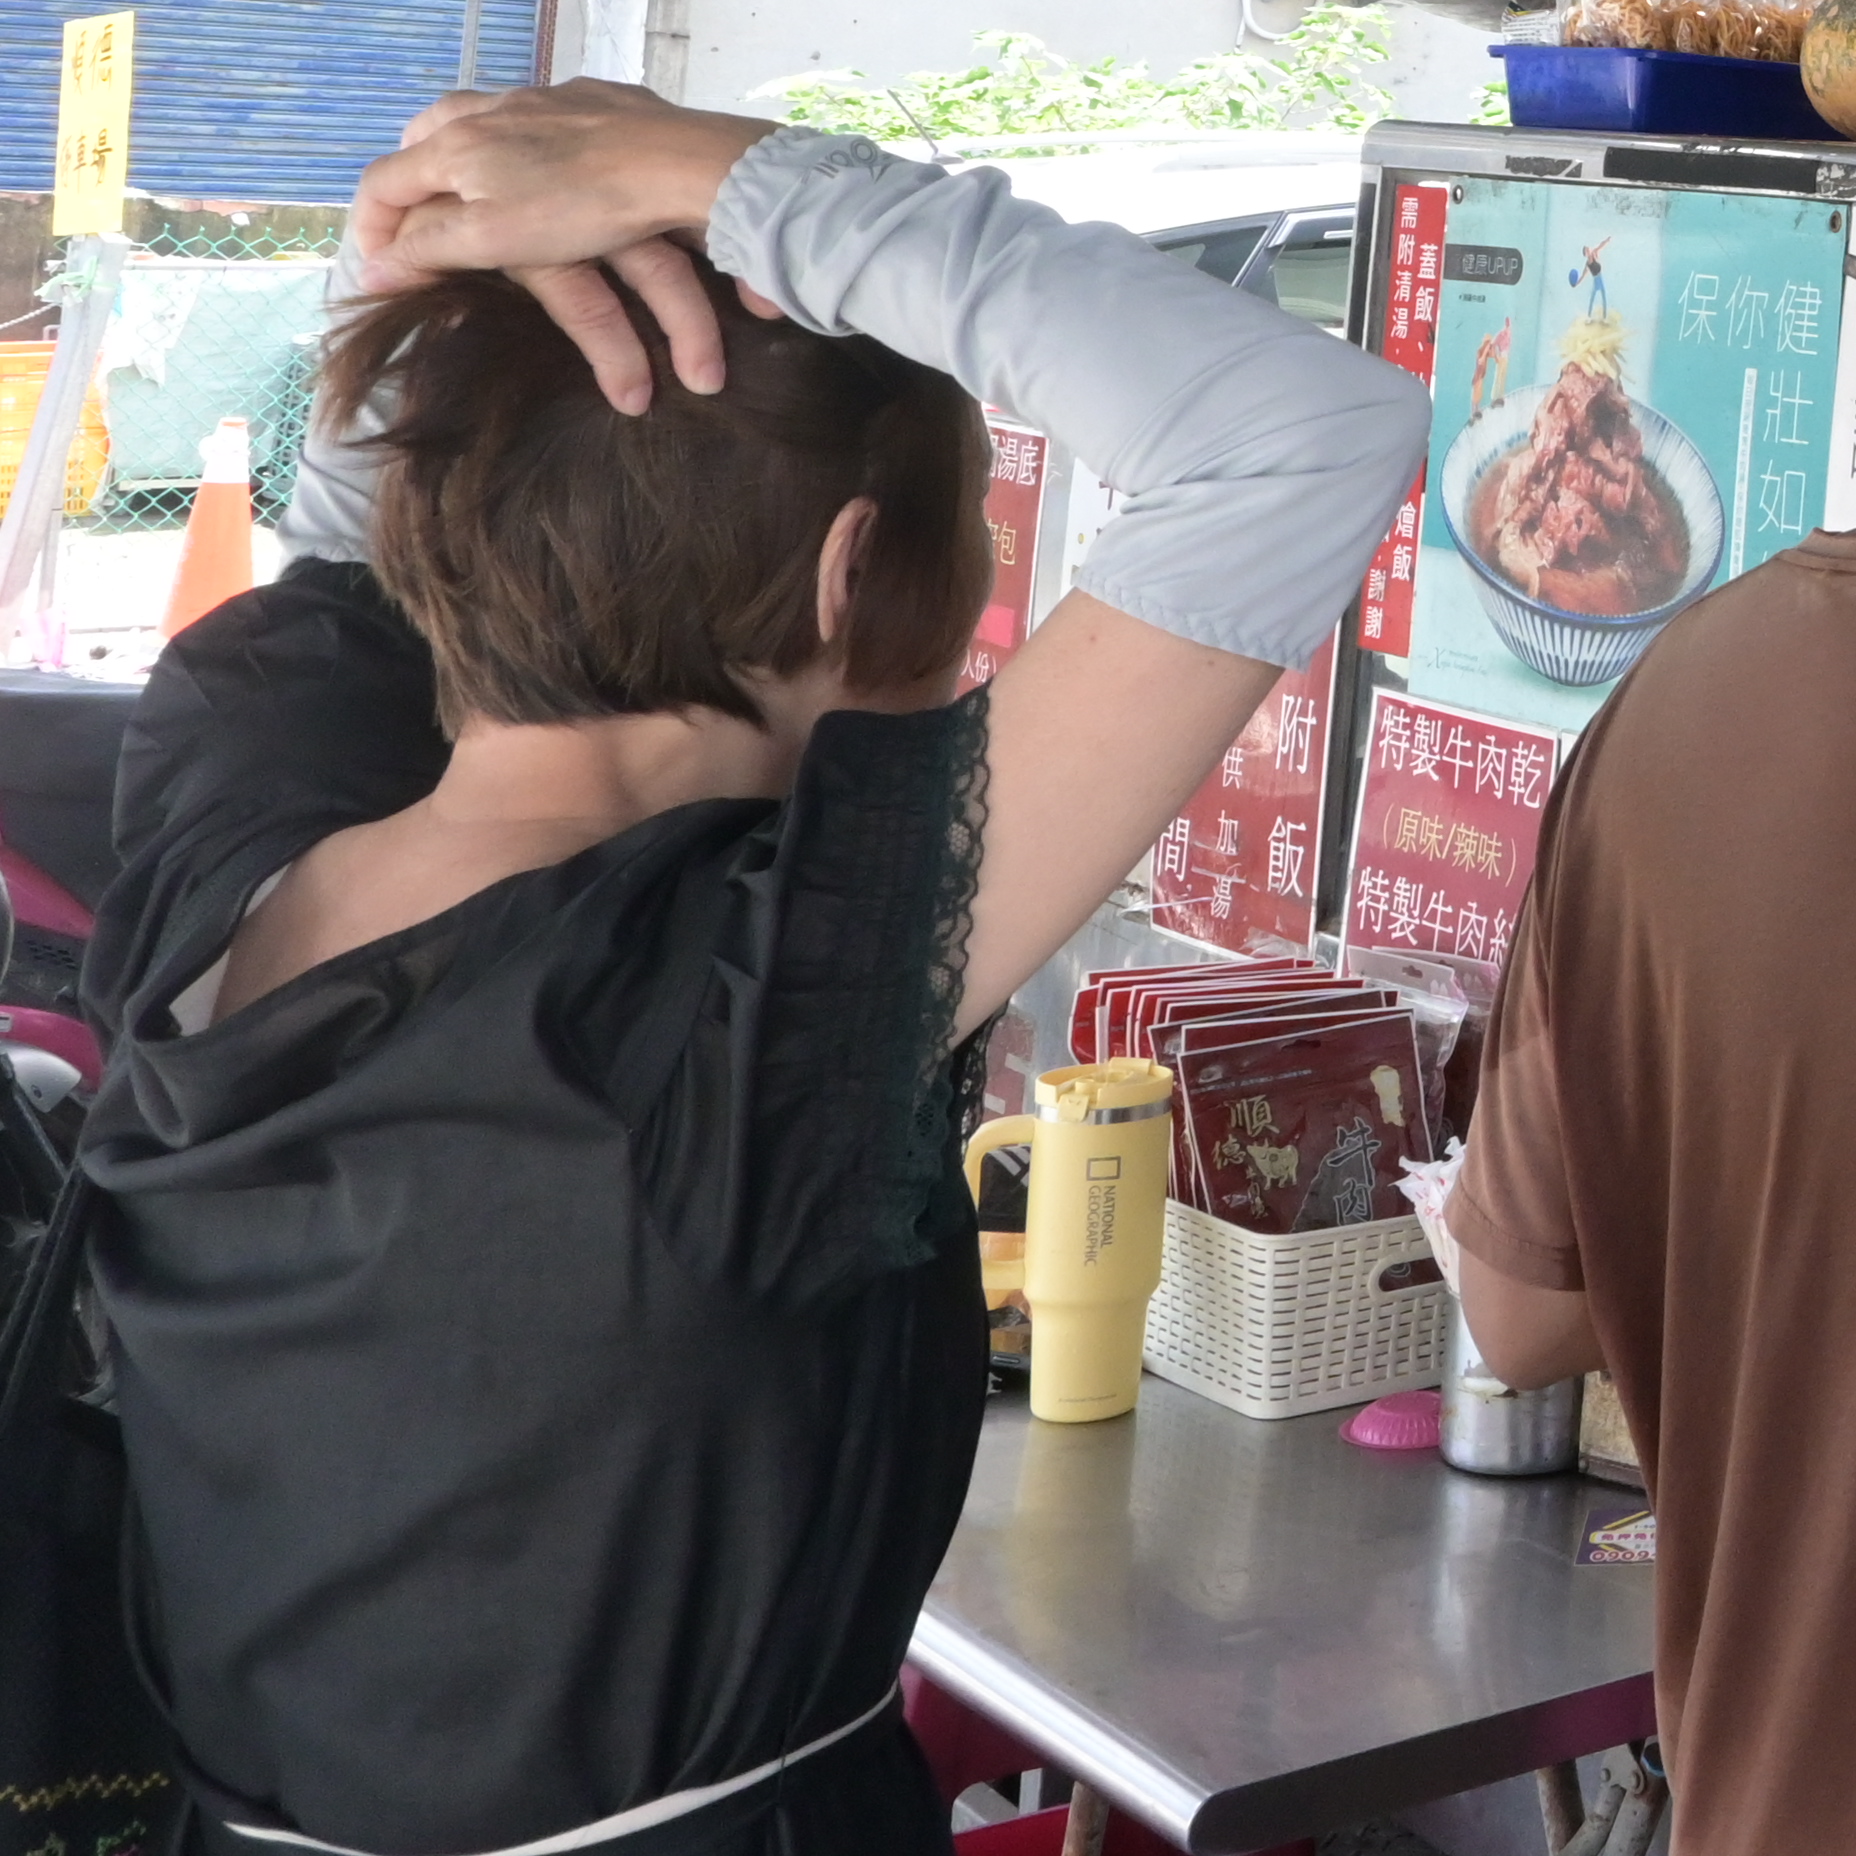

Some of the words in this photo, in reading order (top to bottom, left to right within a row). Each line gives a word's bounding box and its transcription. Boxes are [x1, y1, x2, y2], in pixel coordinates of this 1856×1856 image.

[1379, 705, 1545, 809] 特製牛肉乾
[1100, 1185, 1116, 1248] NATIONAL
[1326, 1116, 1382, 1226] 牛肉
[1084, 1185, 1100, 1267] GEOGRAPHIC
